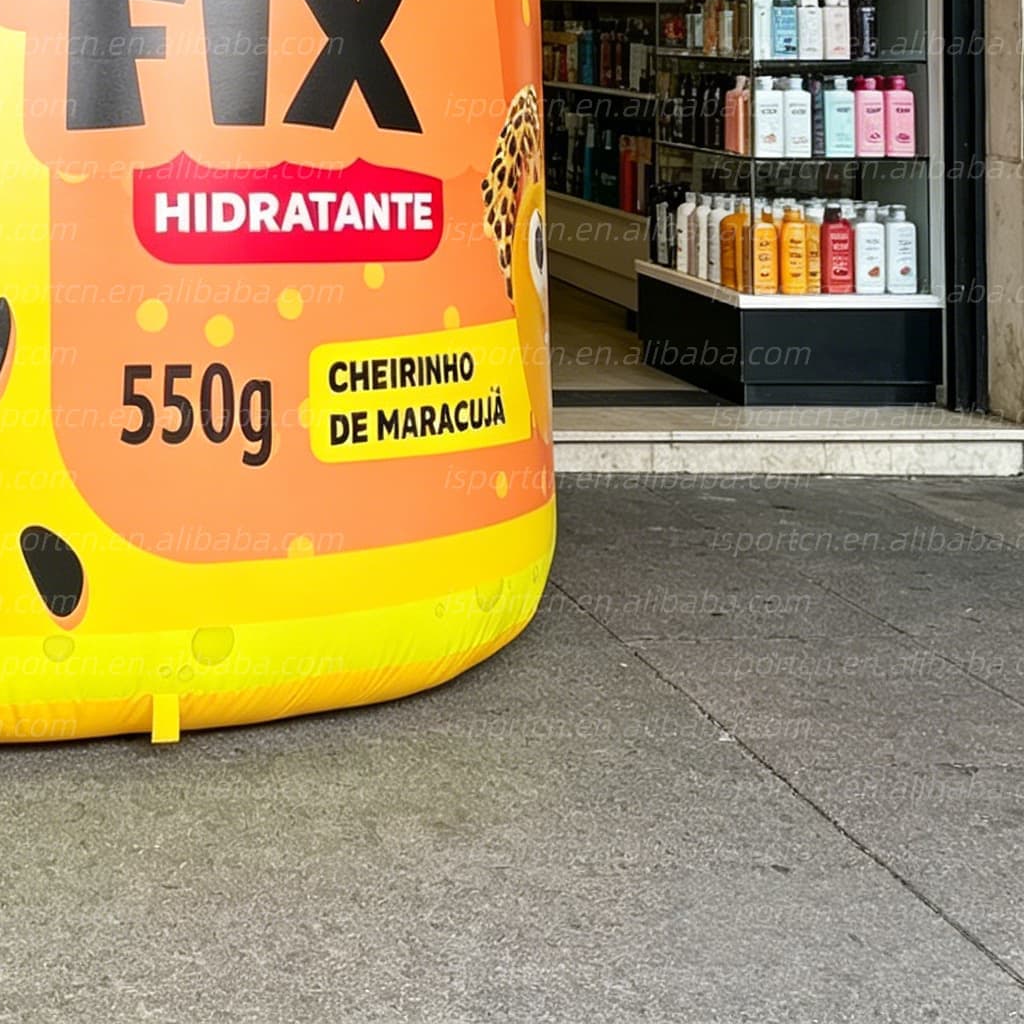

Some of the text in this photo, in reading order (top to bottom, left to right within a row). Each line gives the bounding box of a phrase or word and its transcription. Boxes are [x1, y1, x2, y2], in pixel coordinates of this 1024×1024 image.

[154, 192, 433, 233] HIDRATANTE
[328, 352, 474, 393] CHEIRINHO
[120, 362, 273, 467] 550g
[329, 411, 368, 446] DE
